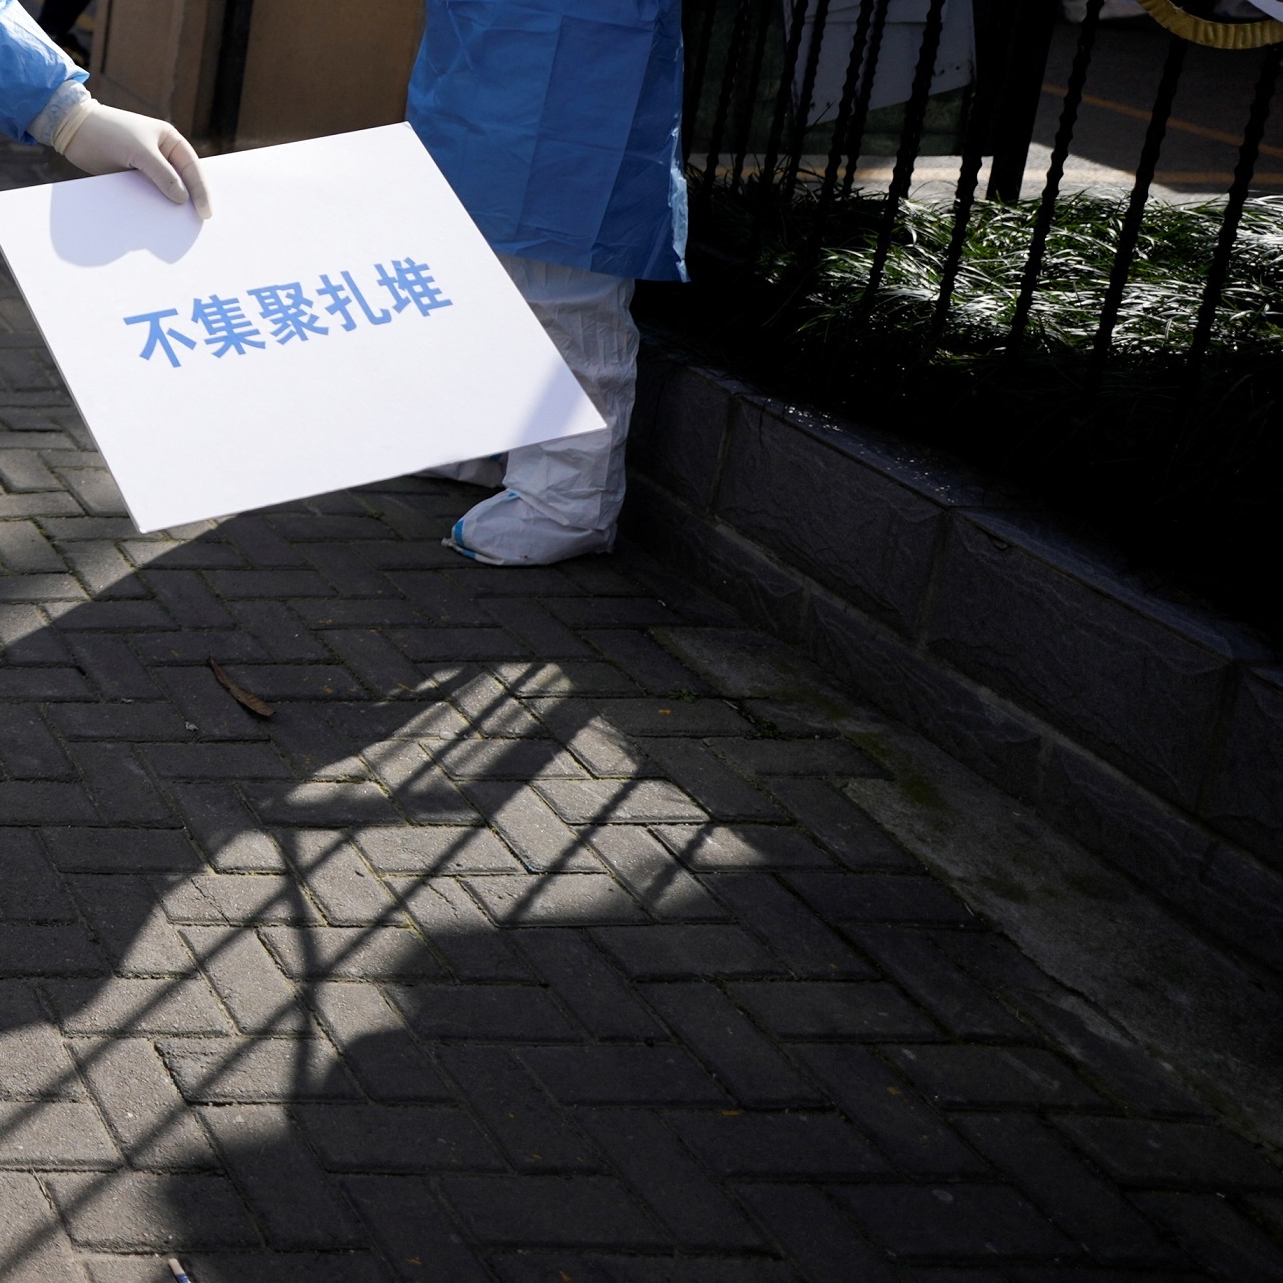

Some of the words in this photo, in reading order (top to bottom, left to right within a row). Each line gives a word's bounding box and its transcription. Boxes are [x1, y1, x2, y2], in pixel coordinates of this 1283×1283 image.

[122, 255, 453, 369] 不集聚扎堆
